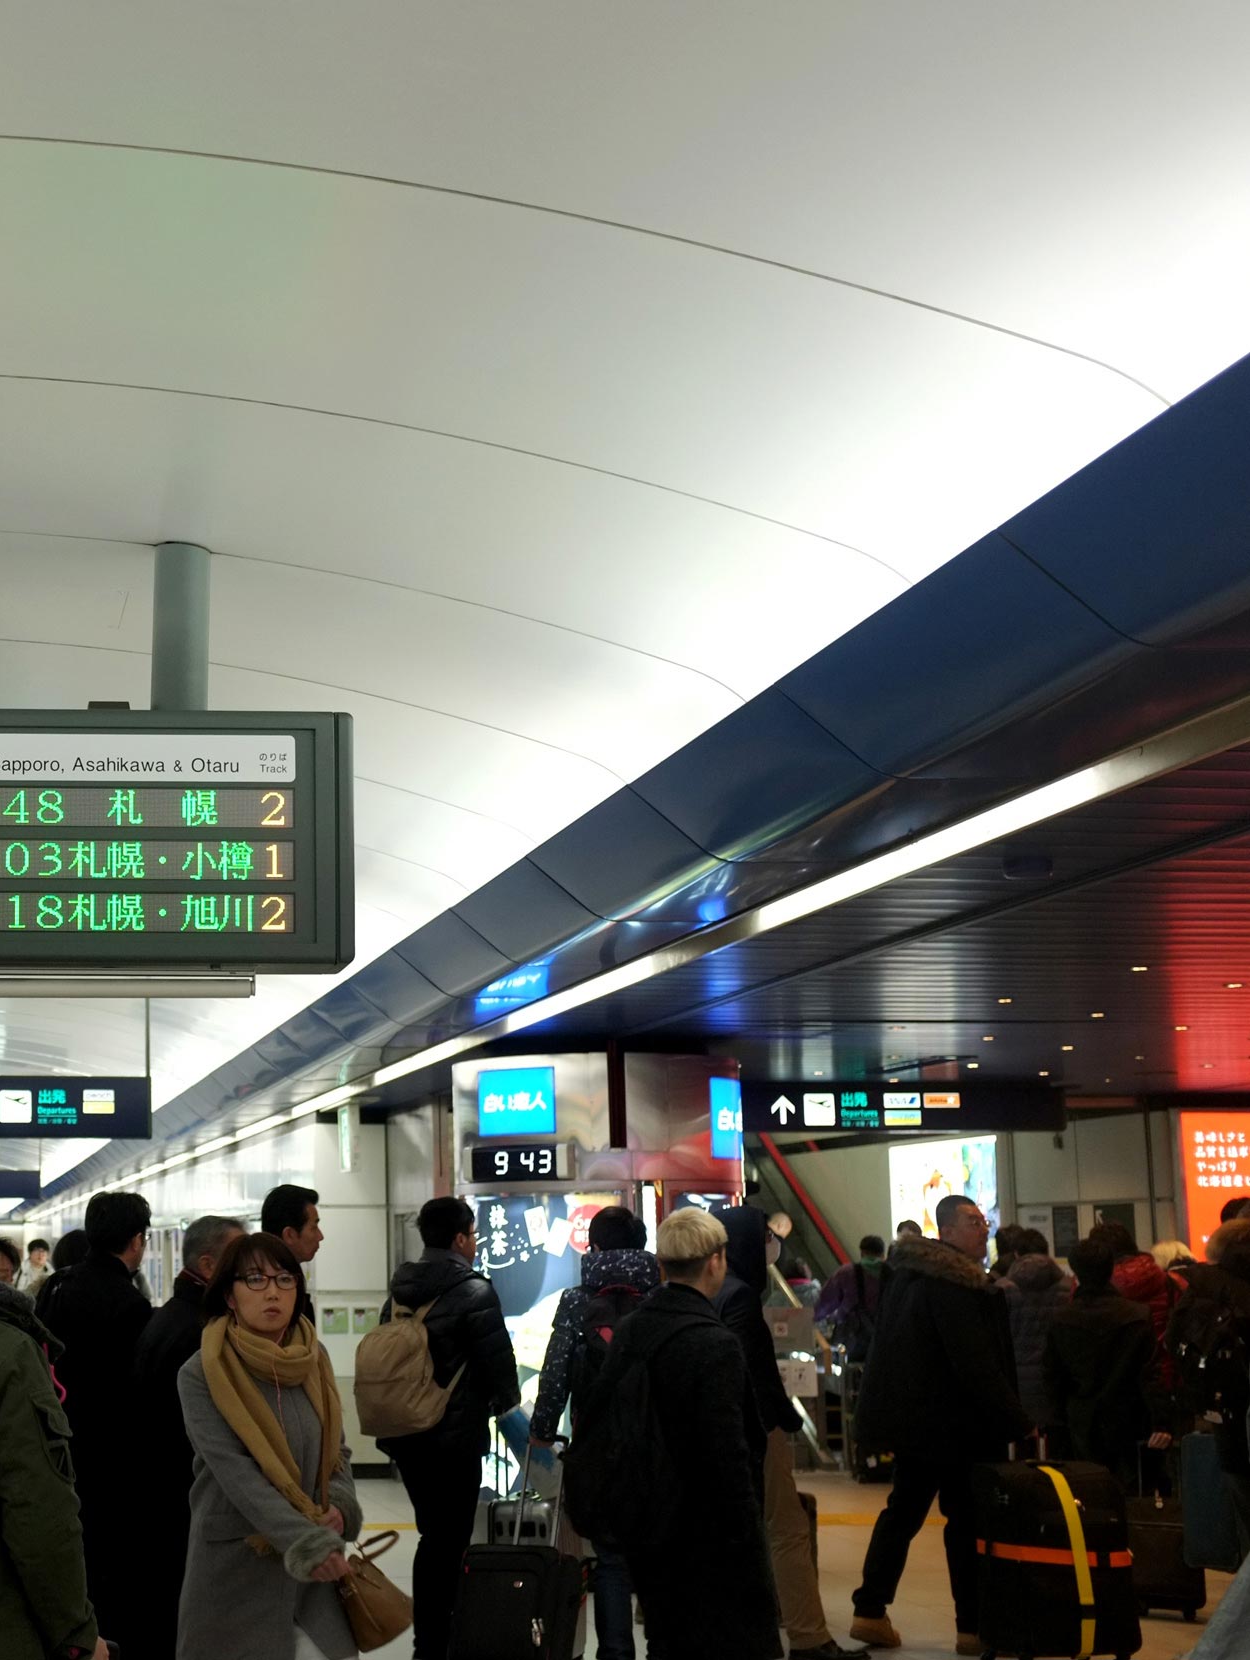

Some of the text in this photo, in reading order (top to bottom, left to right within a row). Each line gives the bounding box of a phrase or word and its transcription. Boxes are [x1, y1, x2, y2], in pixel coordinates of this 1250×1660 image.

[72, 756, 165, 773] Asahikawa
[173, 759, 183, 773] &
[191, 757, 239, 773] Otaru
[259, 752, 287, 762] のりば
[260, 763, 287, 774] Track
[260, 791, 285, 826] 2
[68, 841, 254, 881] 札幌・小樽
[265, 844, 284, 878] 1
[68, 893, 254, 932] 札幌・旭川
[261, 896, 286, 931] 2
[38, 1089, 66, 1104] 出発
[841, 1092, 868, 1107] 出発
[37, 1106, 77, 1116] Departures
[841, 1109, 879, 1119] Departures
[1197, 1160, 1237, 1173] やっぱり
